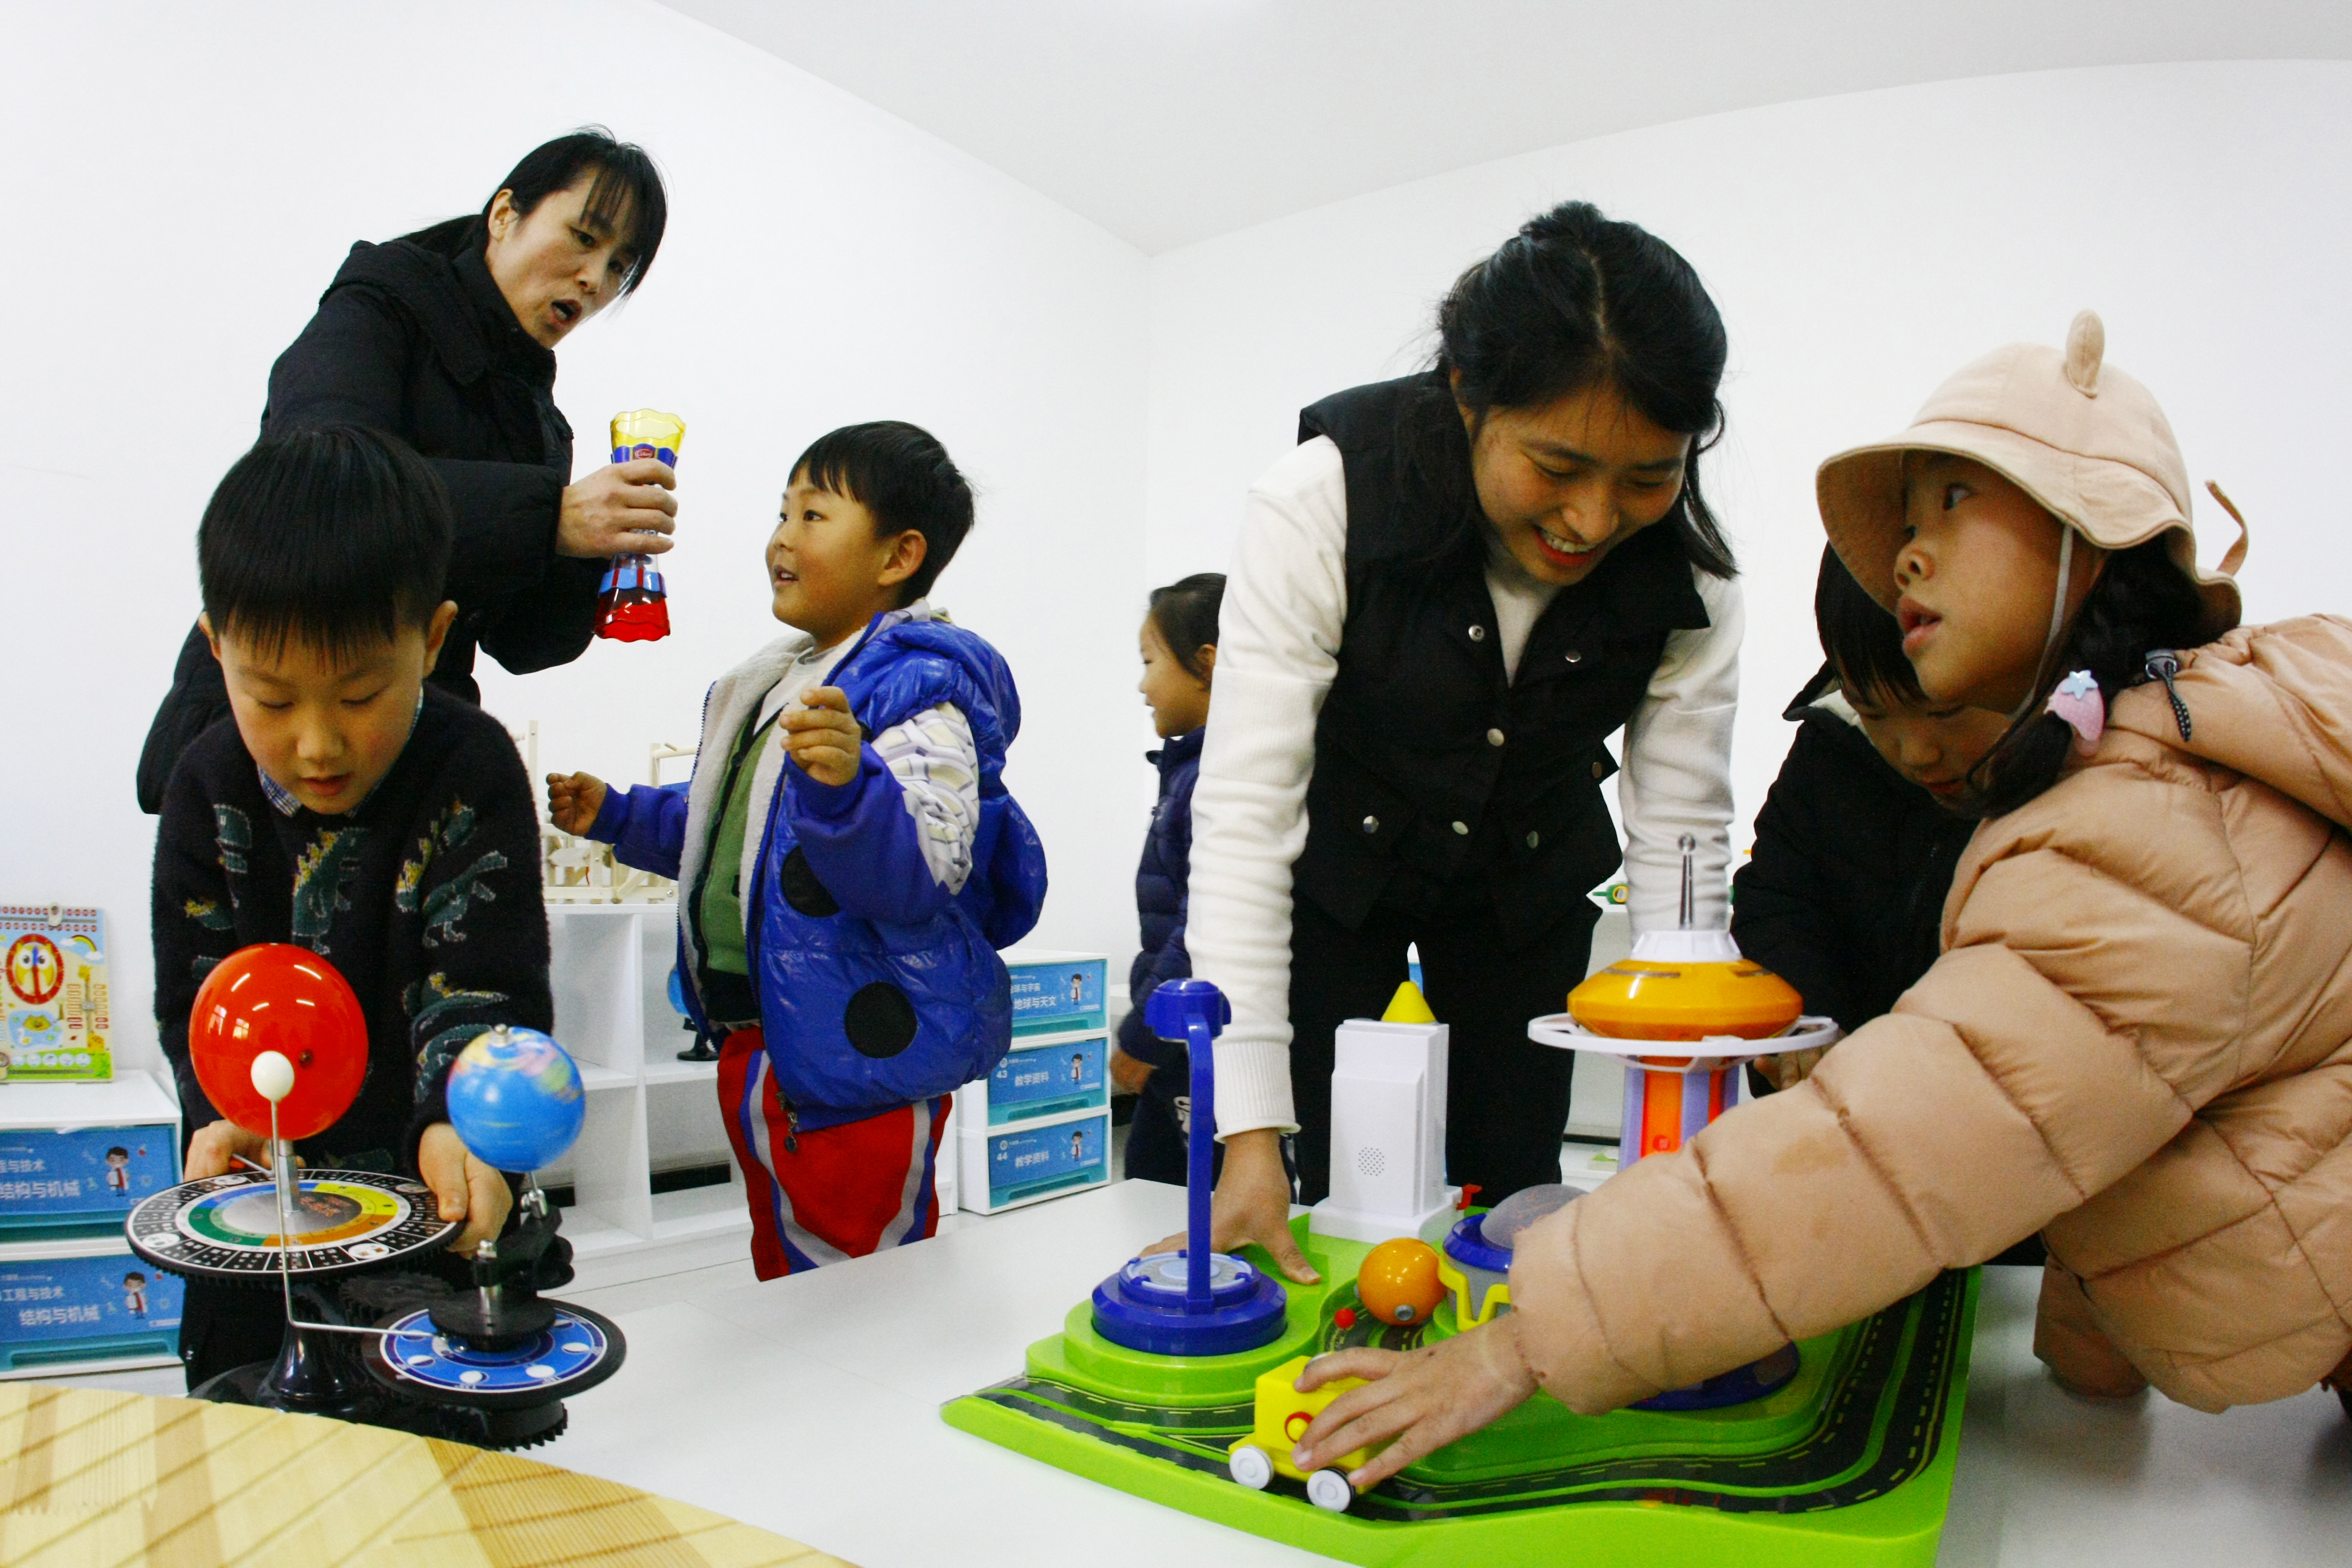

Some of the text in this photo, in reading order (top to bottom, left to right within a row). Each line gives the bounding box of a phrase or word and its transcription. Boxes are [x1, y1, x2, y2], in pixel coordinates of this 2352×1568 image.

[1014, 996, 1056, 1010] 地球与天文
[996, 1070, 1008, 1079] 43
[1014, 1071, 1049, 1086] 教学资料
[997, 1152, 1008, 1161] 44
[1015, 1151, 1050, 1168] 教学资料
[0, 1180, 80, 1199] 结构与机械
[19, 1305, 100, 1325] 结构与机械
